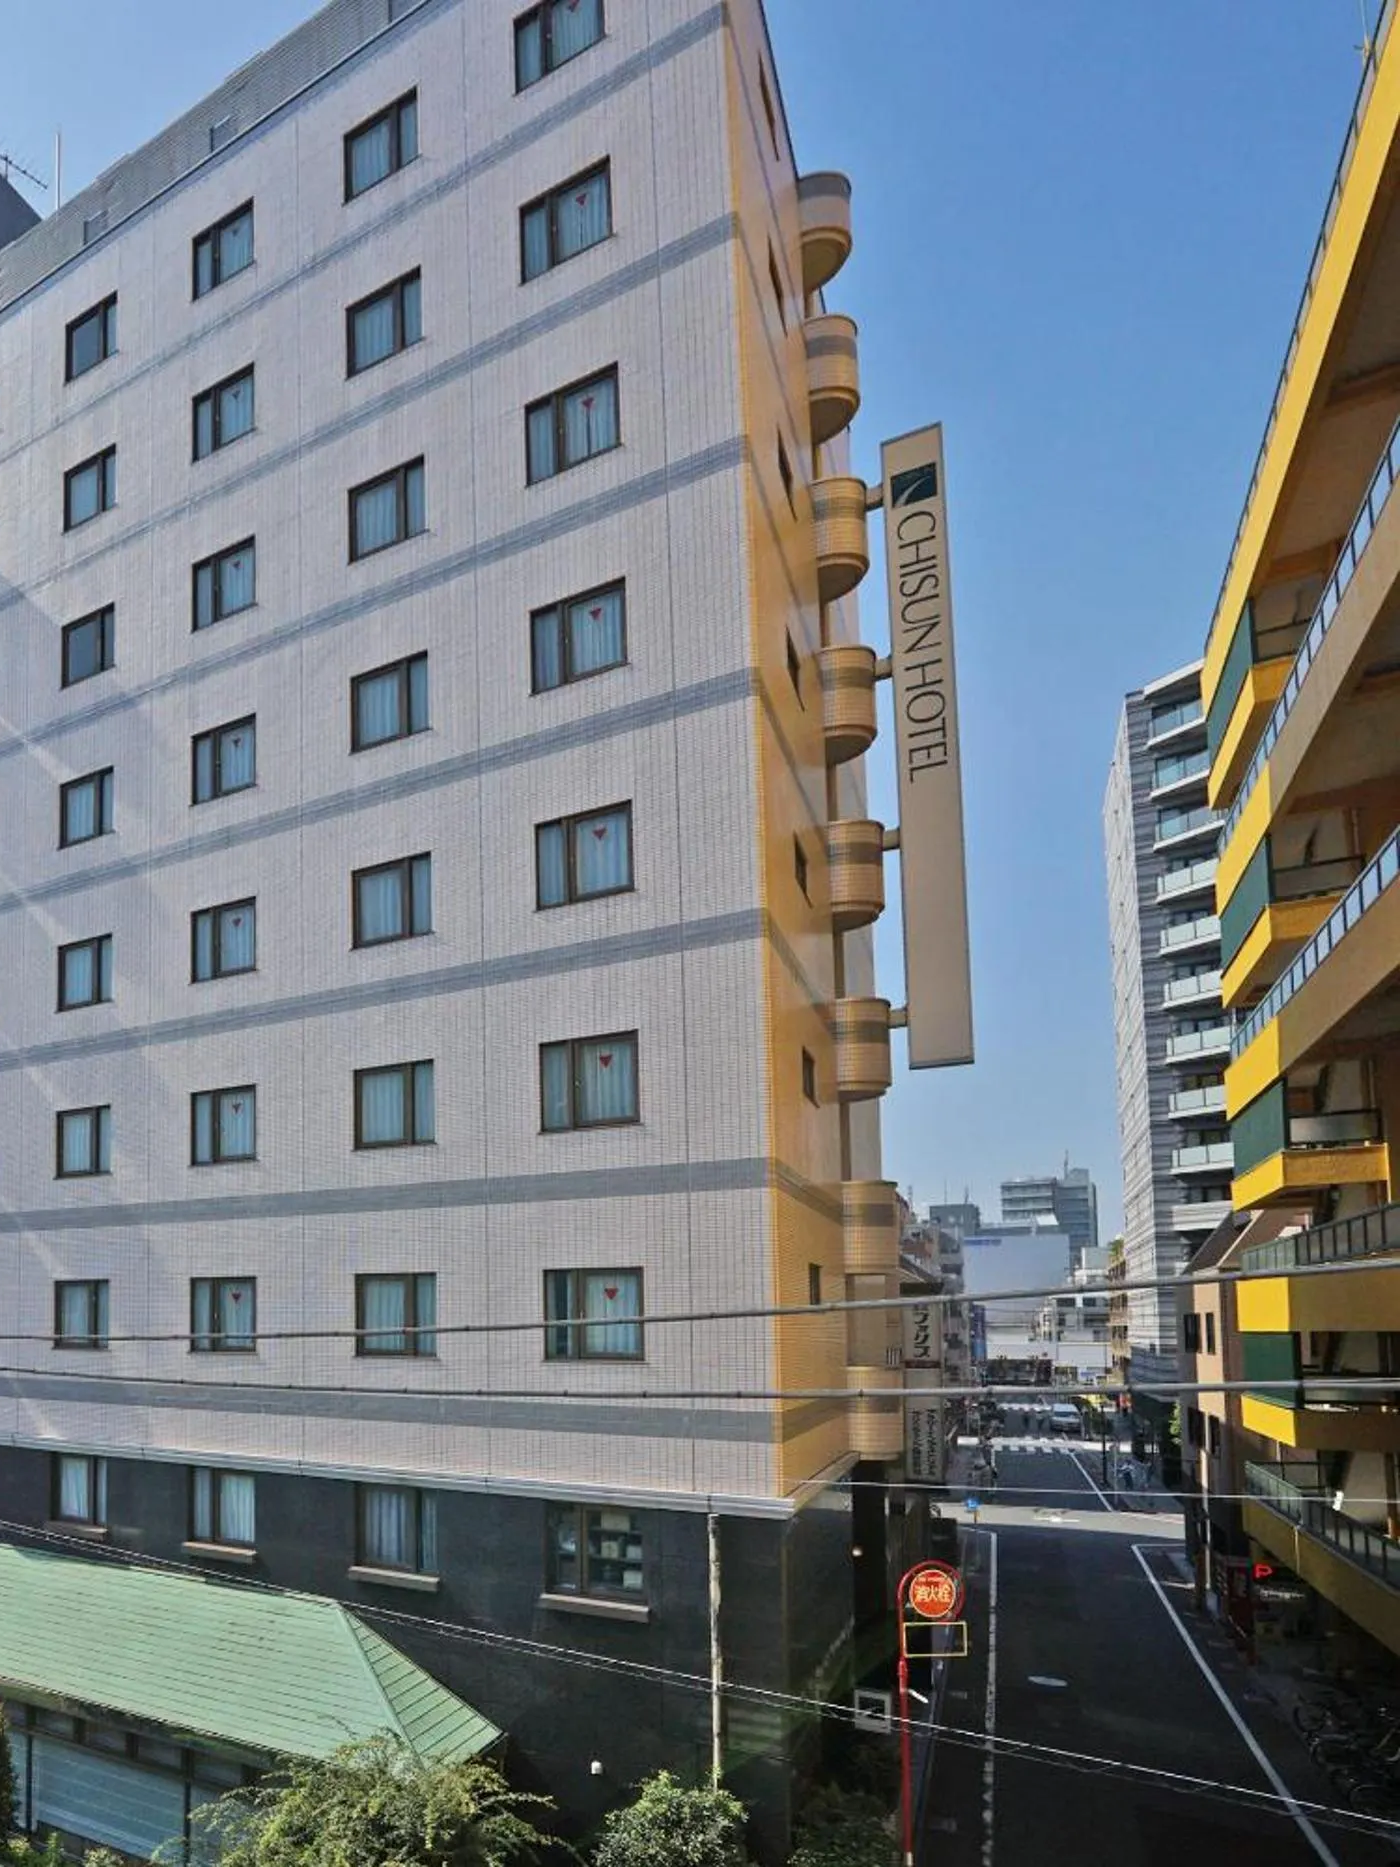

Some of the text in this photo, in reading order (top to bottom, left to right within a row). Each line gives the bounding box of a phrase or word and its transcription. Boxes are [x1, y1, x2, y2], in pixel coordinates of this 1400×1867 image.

[897, 510, 948, 783] CHISUN HOTEL
[1253, 1563, 1274, 1579] P
[914, 1584, 952, 1603] 消火栓
